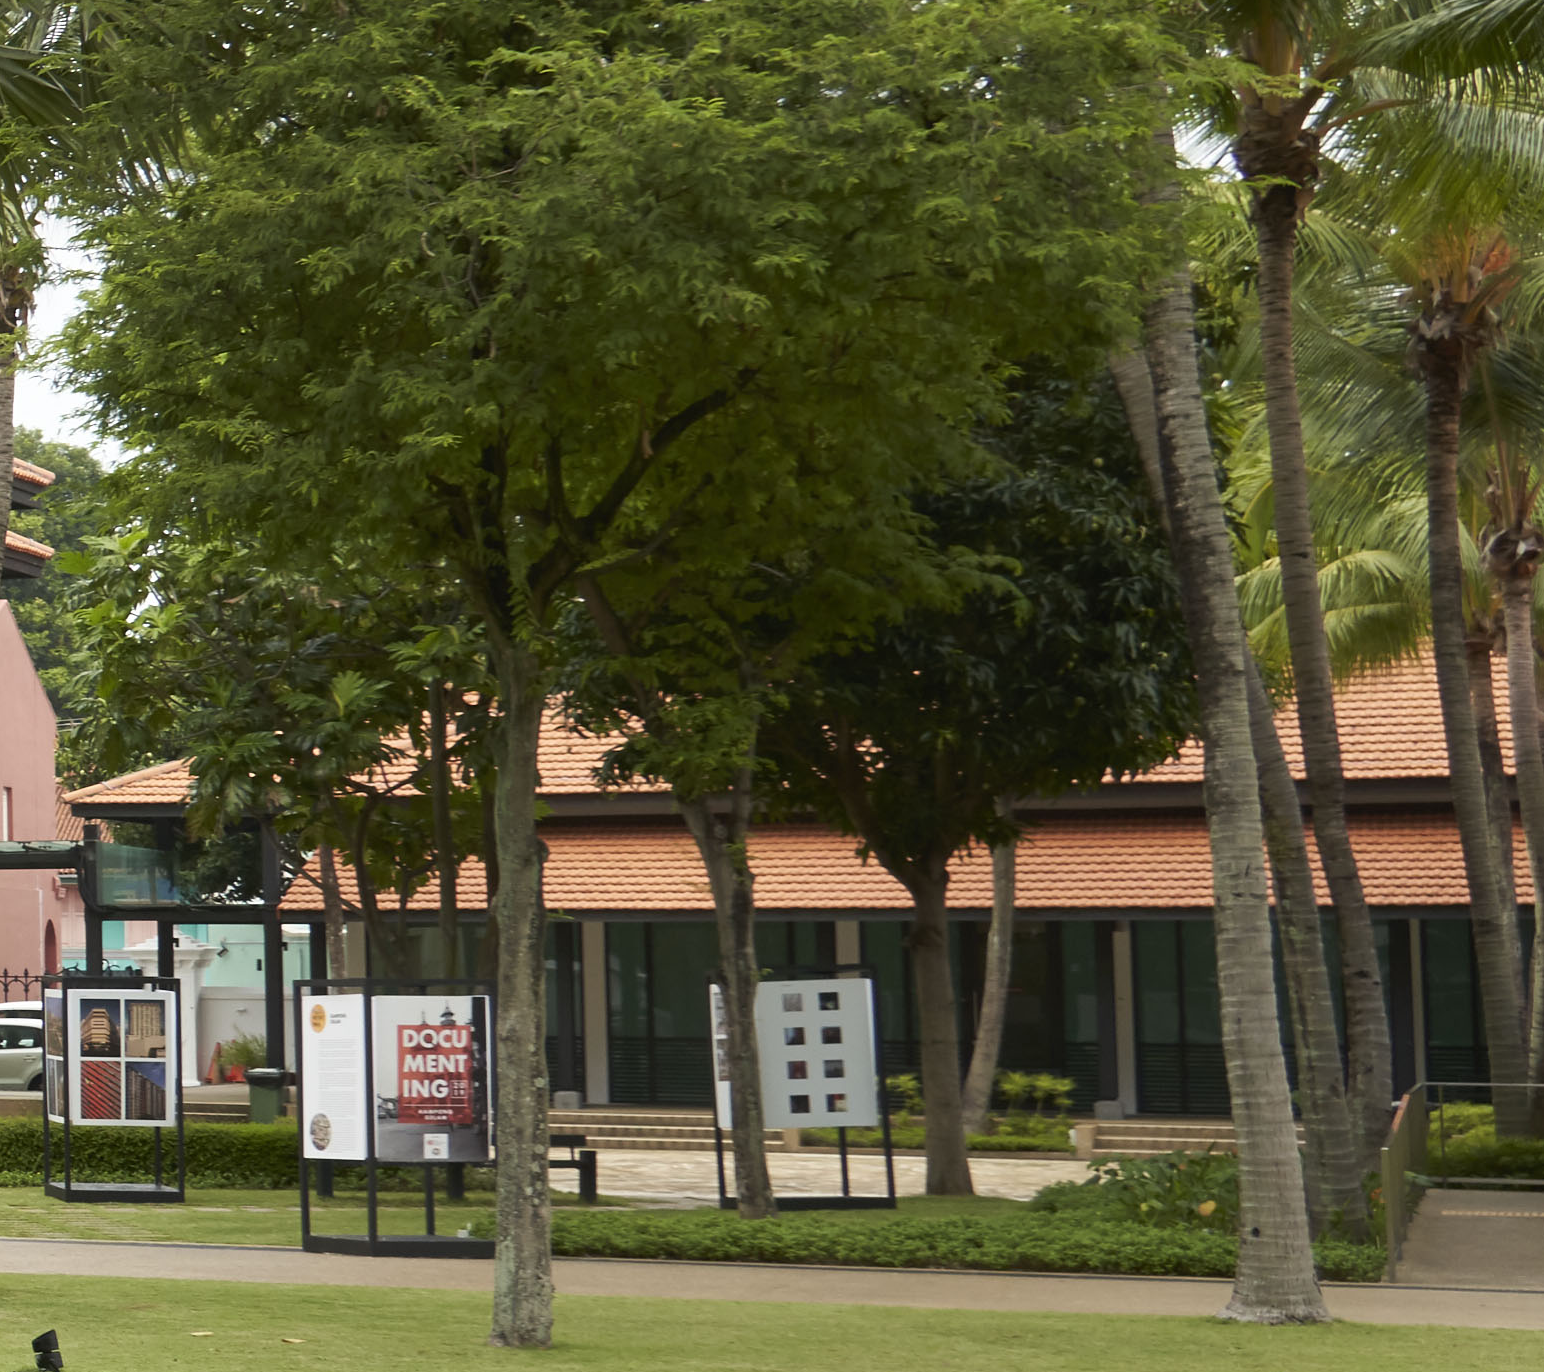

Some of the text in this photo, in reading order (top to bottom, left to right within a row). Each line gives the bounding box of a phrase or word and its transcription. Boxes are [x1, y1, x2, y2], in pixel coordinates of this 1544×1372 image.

[402, 1029, 467, 1048] DOCU
[403, 1054, 468, 1072] MENT
[402, 1078, 449, 1098] ING
